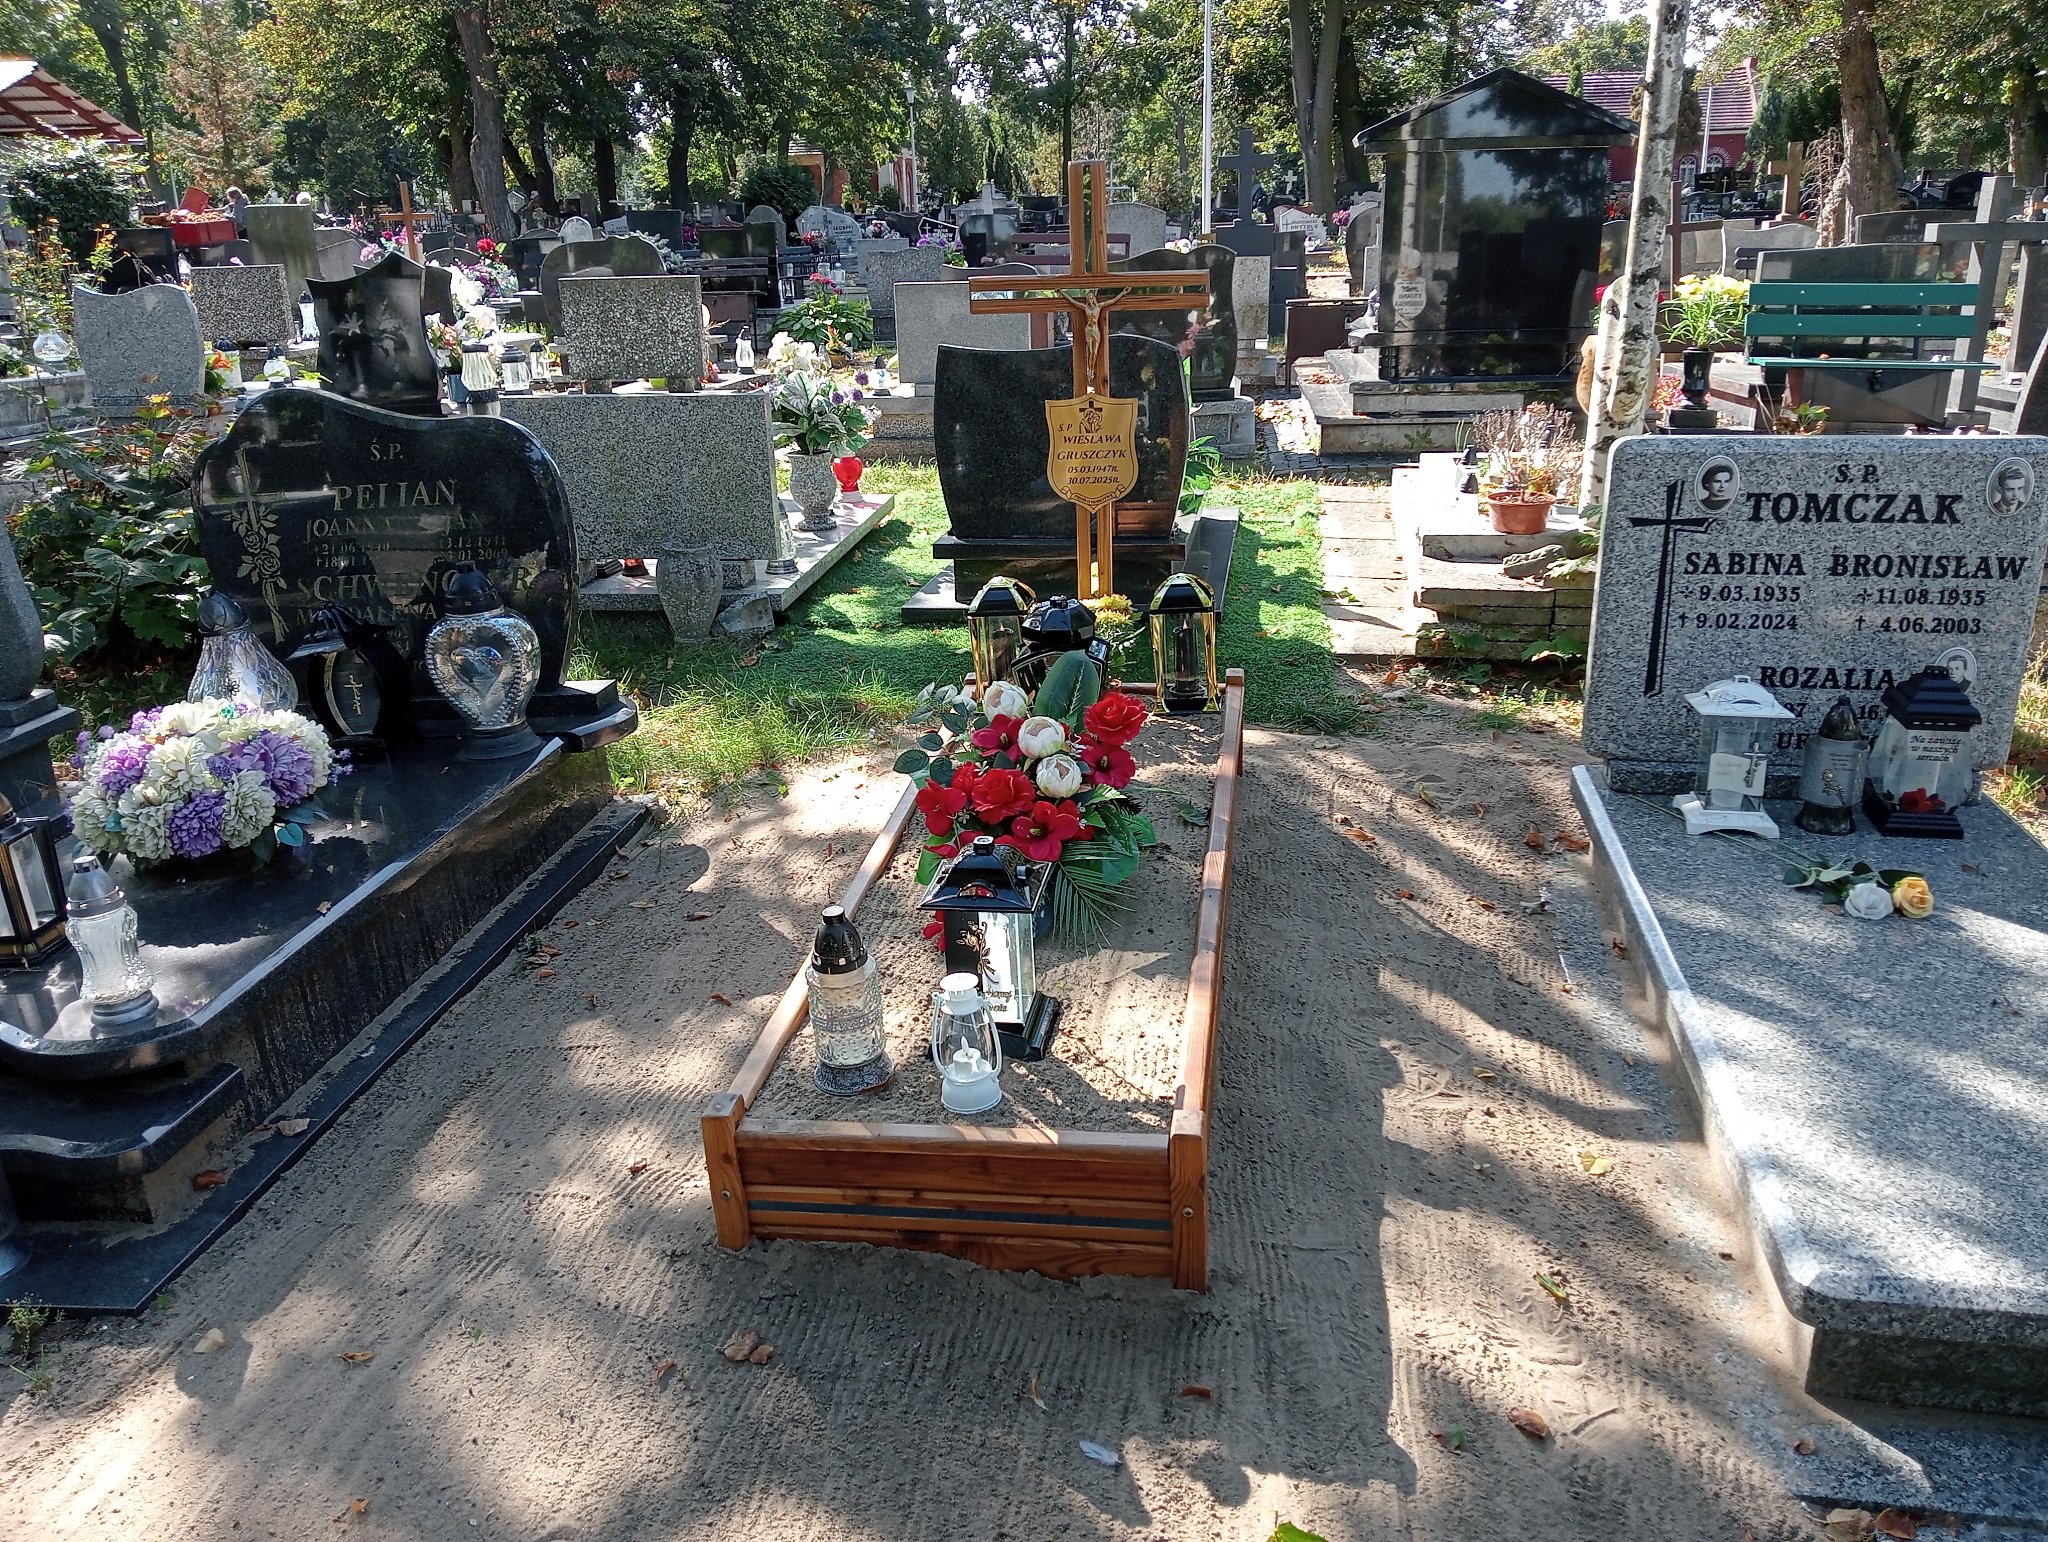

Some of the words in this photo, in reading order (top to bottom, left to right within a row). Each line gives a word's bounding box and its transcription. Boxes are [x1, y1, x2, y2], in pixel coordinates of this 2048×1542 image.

[1063, 434, 1122, 445] WIESŁAWA
[1057, 449, 1127, 460] GRUSZCZYK
[332, 479, 456, 511] PELIAN
[1745, 492, 1963, 525] TOMCZAK
[1683, 552, 1807, 576] SABINA
[1828, 553, 2029, 582] BRONISŁAW
[1699, 585, 1801, 603] 9.03.1935
[1876, 588, 1987, 607] 11.08.1935
[1696, 612, 1799, 631] 9.02.2024
[1880, 616, 1983, 635] 4.06.2003
[1759, 666, 1897, 692] ROZALIA
[1910, 735, 1926, 744] Na
[1922, 744, 1959, 756] naszych
